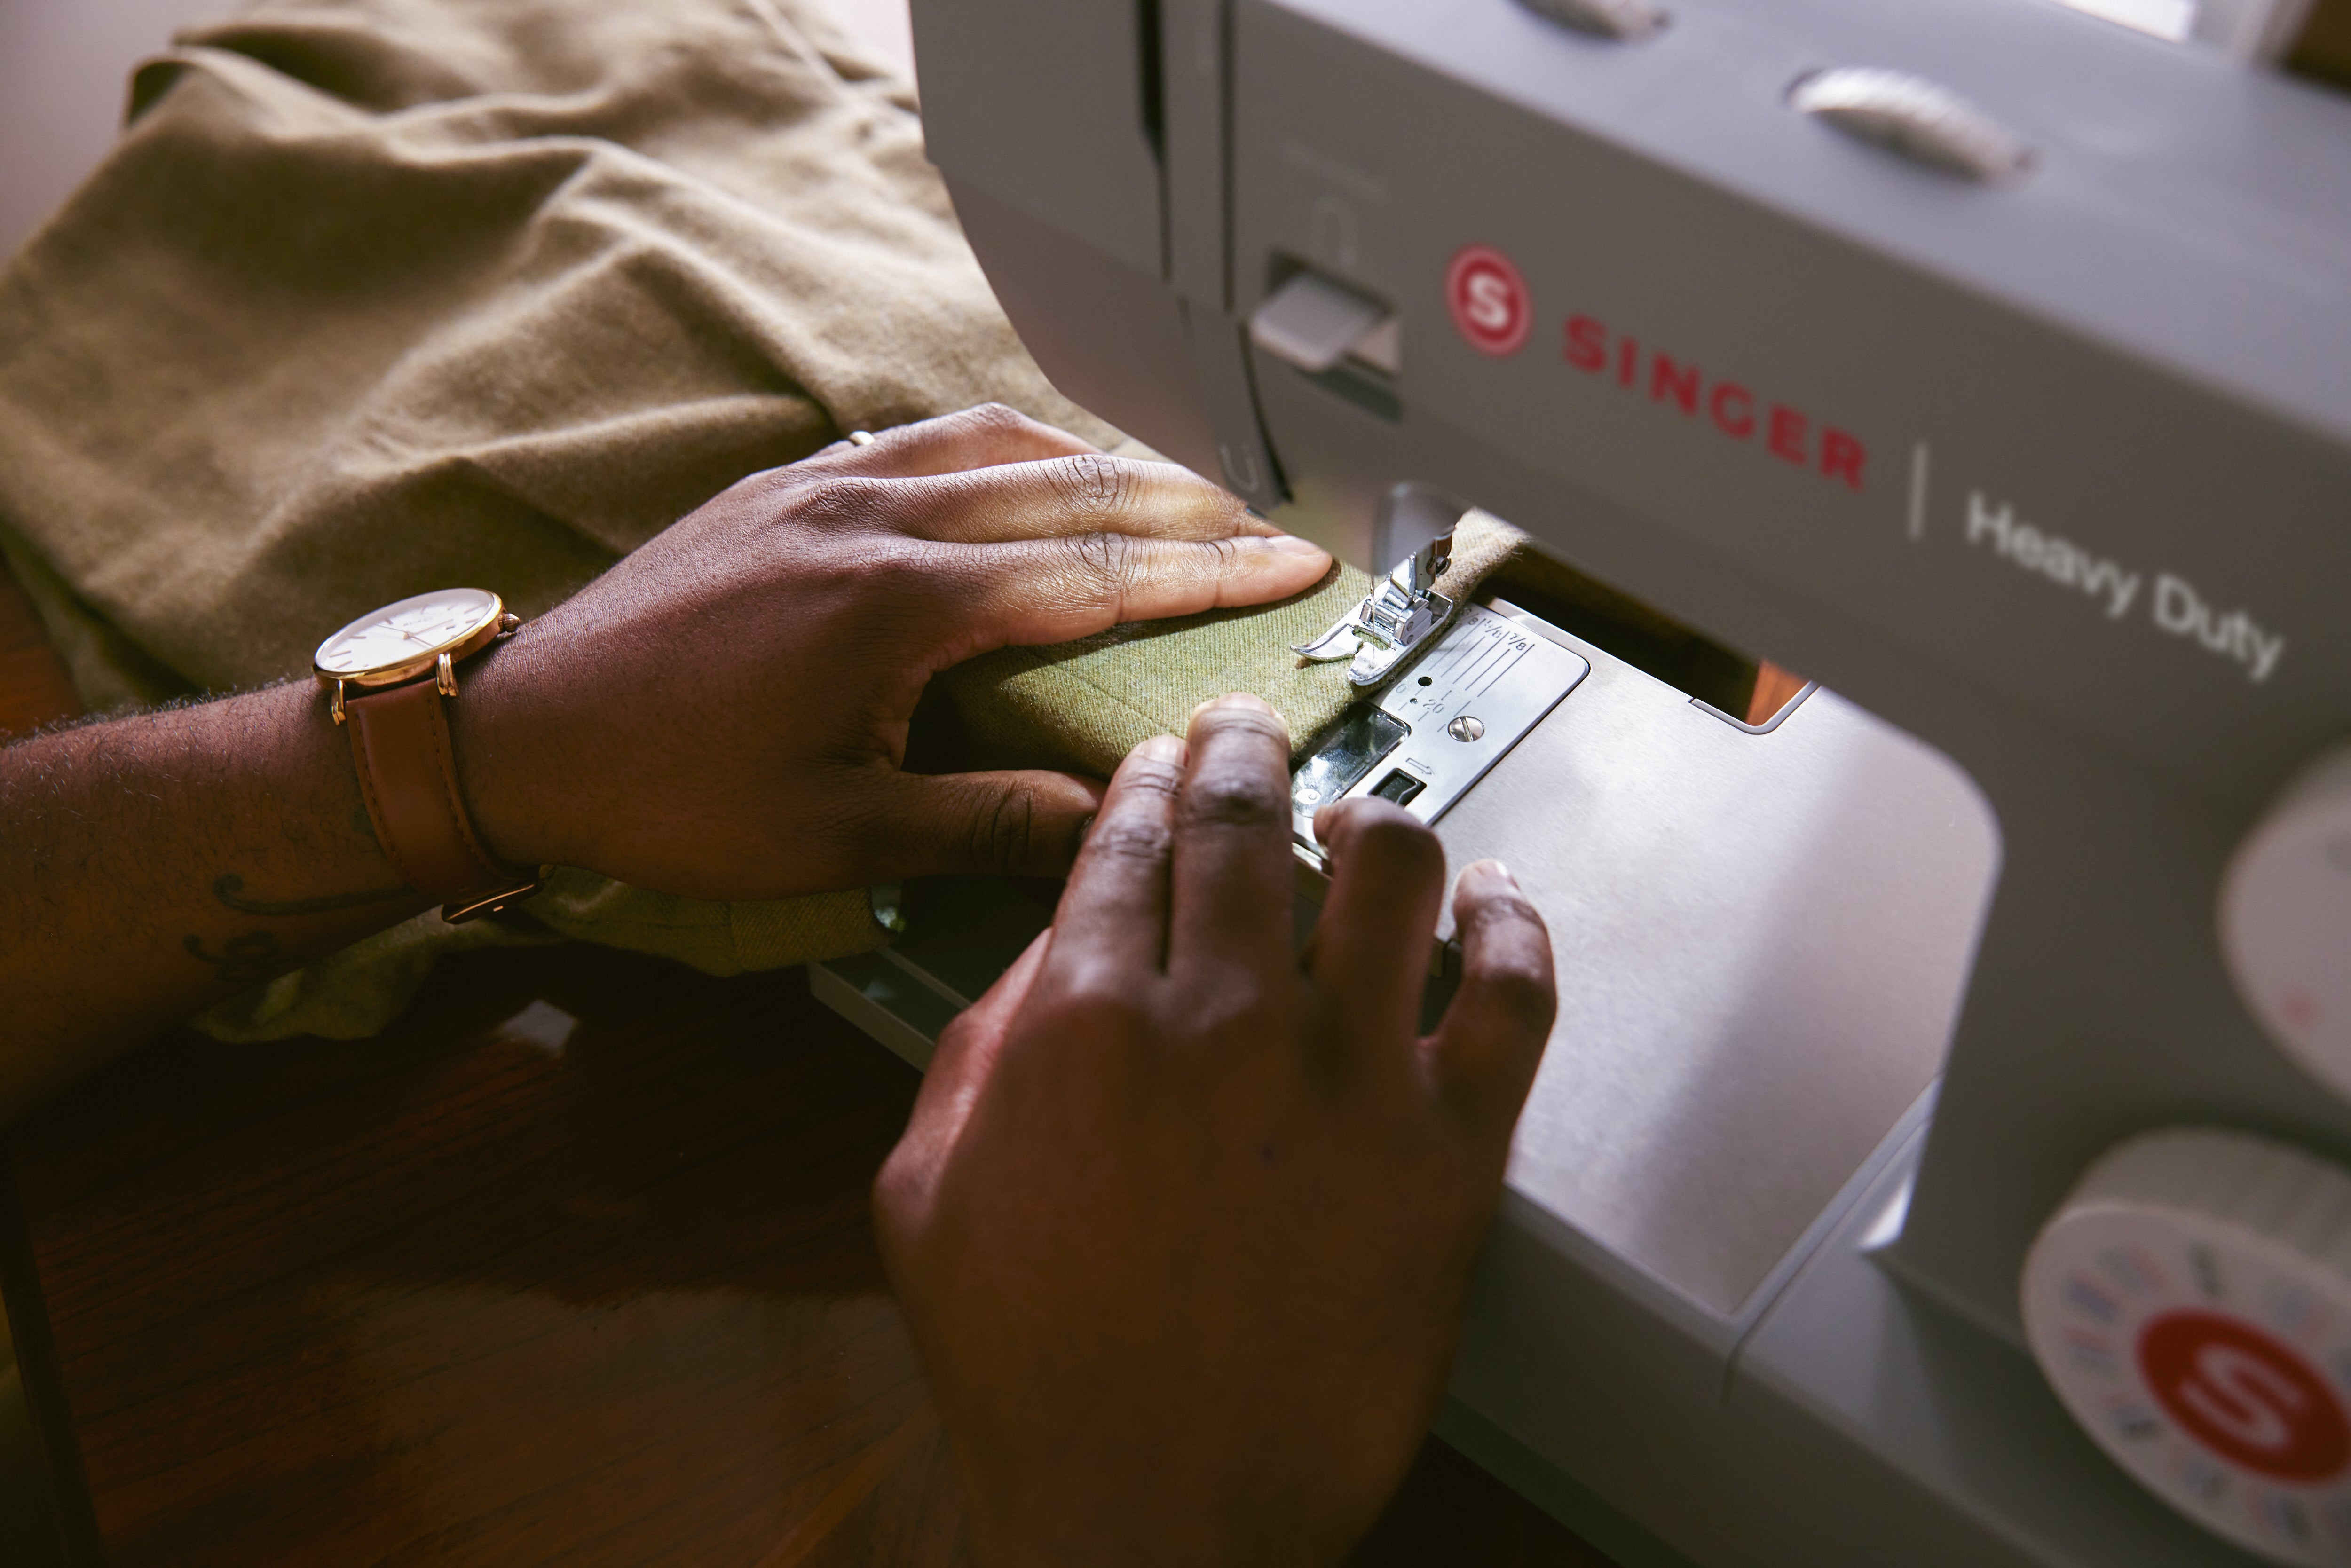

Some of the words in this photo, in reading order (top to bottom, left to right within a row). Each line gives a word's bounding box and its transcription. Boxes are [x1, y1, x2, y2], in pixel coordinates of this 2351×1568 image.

[1467, 272, 1510, 330] S
[1563, 314, 1867, 490] SINGER
[1968, 492, 2140, 619] Heavy
[2154, 574, 2283, 682] Duty
[1508, 633, 1527, 651] 7/8
[1423, 699, 1444, 713] 20
[2180, 1340, 2306, 1453] S
